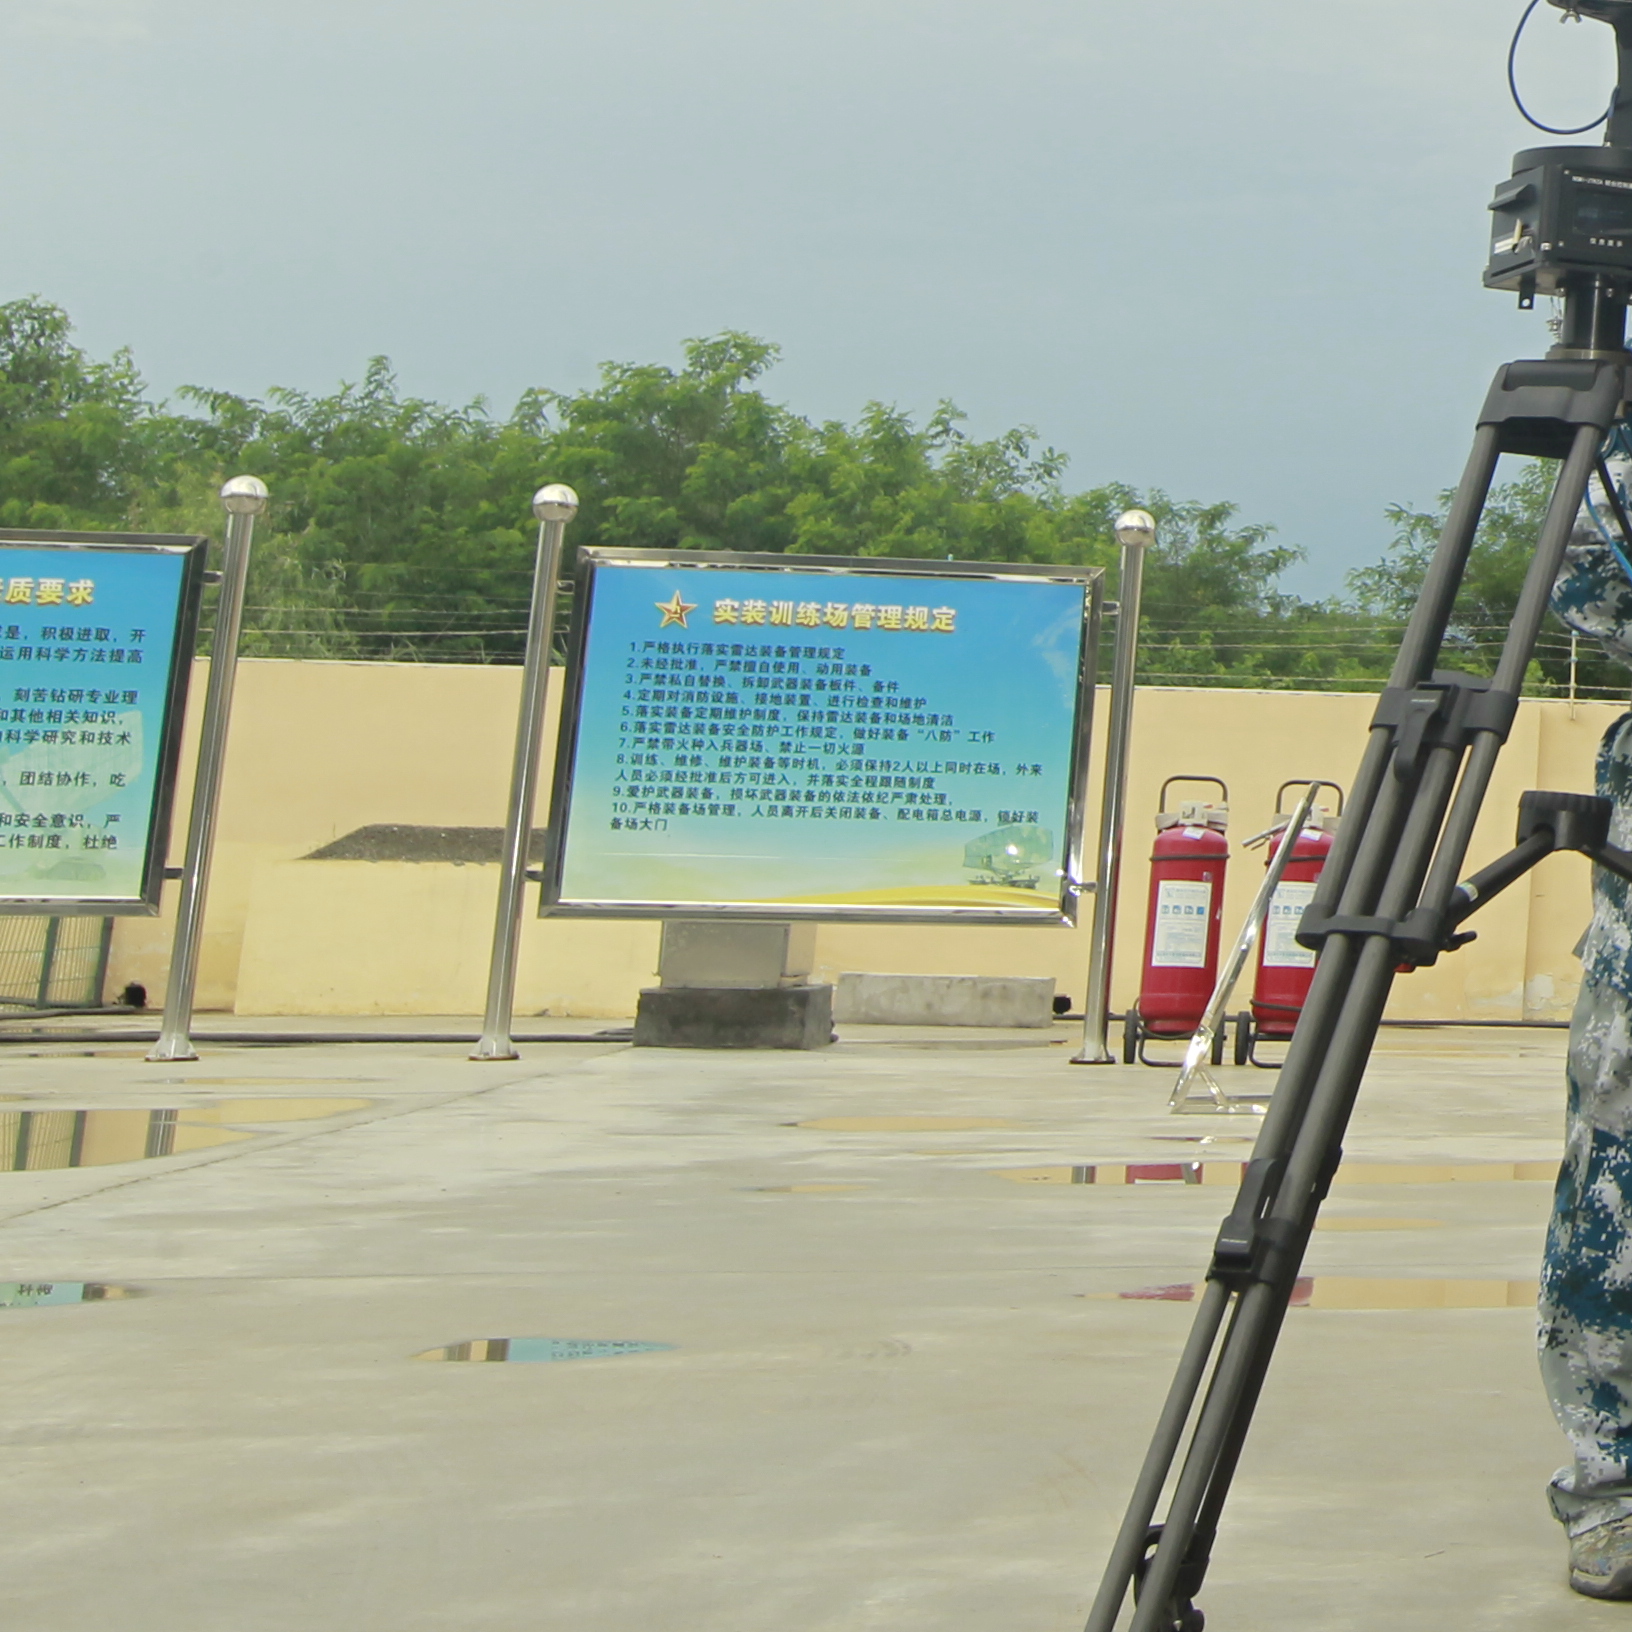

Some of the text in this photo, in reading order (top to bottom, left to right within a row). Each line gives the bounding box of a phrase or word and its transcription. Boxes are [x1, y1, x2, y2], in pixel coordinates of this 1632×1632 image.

[0, 577, 95, 606] 质要求
[713, 598, 957, 633] 实装训练场管理规定
[0, 625, 147, 643] 是，积极进取，开
[0, 646, 144, 663] 运用科学方法提高
[629, 640, 846, 660] 1.严格执行落实雷达装备管理规定
[626, 657, 873, 677] 2.未经批准，严禁擅自使用、动用装备
[0, 729, 132, 745] 科学研究和技术
[610, 818, 668, 831] 备场大门
